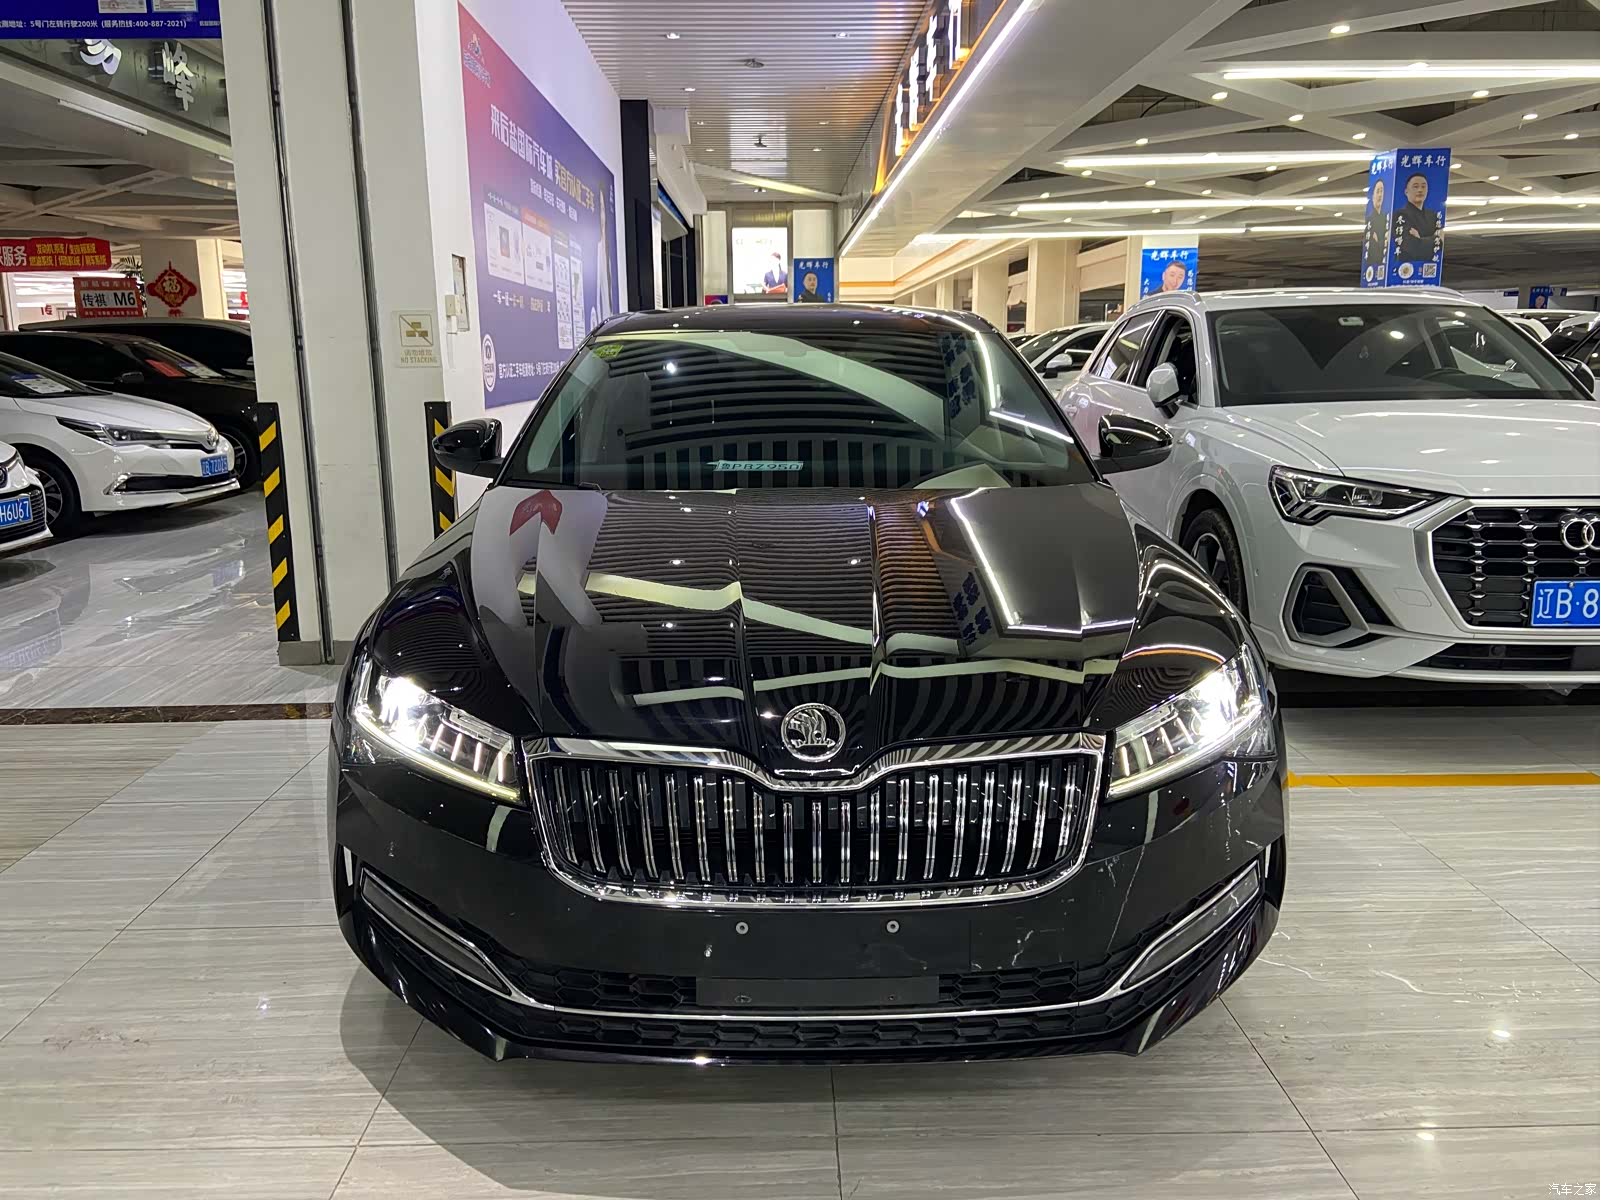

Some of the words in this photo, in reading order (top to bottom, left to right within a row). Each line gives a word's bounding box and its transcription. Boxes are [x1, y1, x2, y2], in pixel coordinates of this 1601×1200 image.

[0, 245, 27, 267] 服务
[82, 292, 107, 307] 传祺
[113, 291, 136, 306] M6
